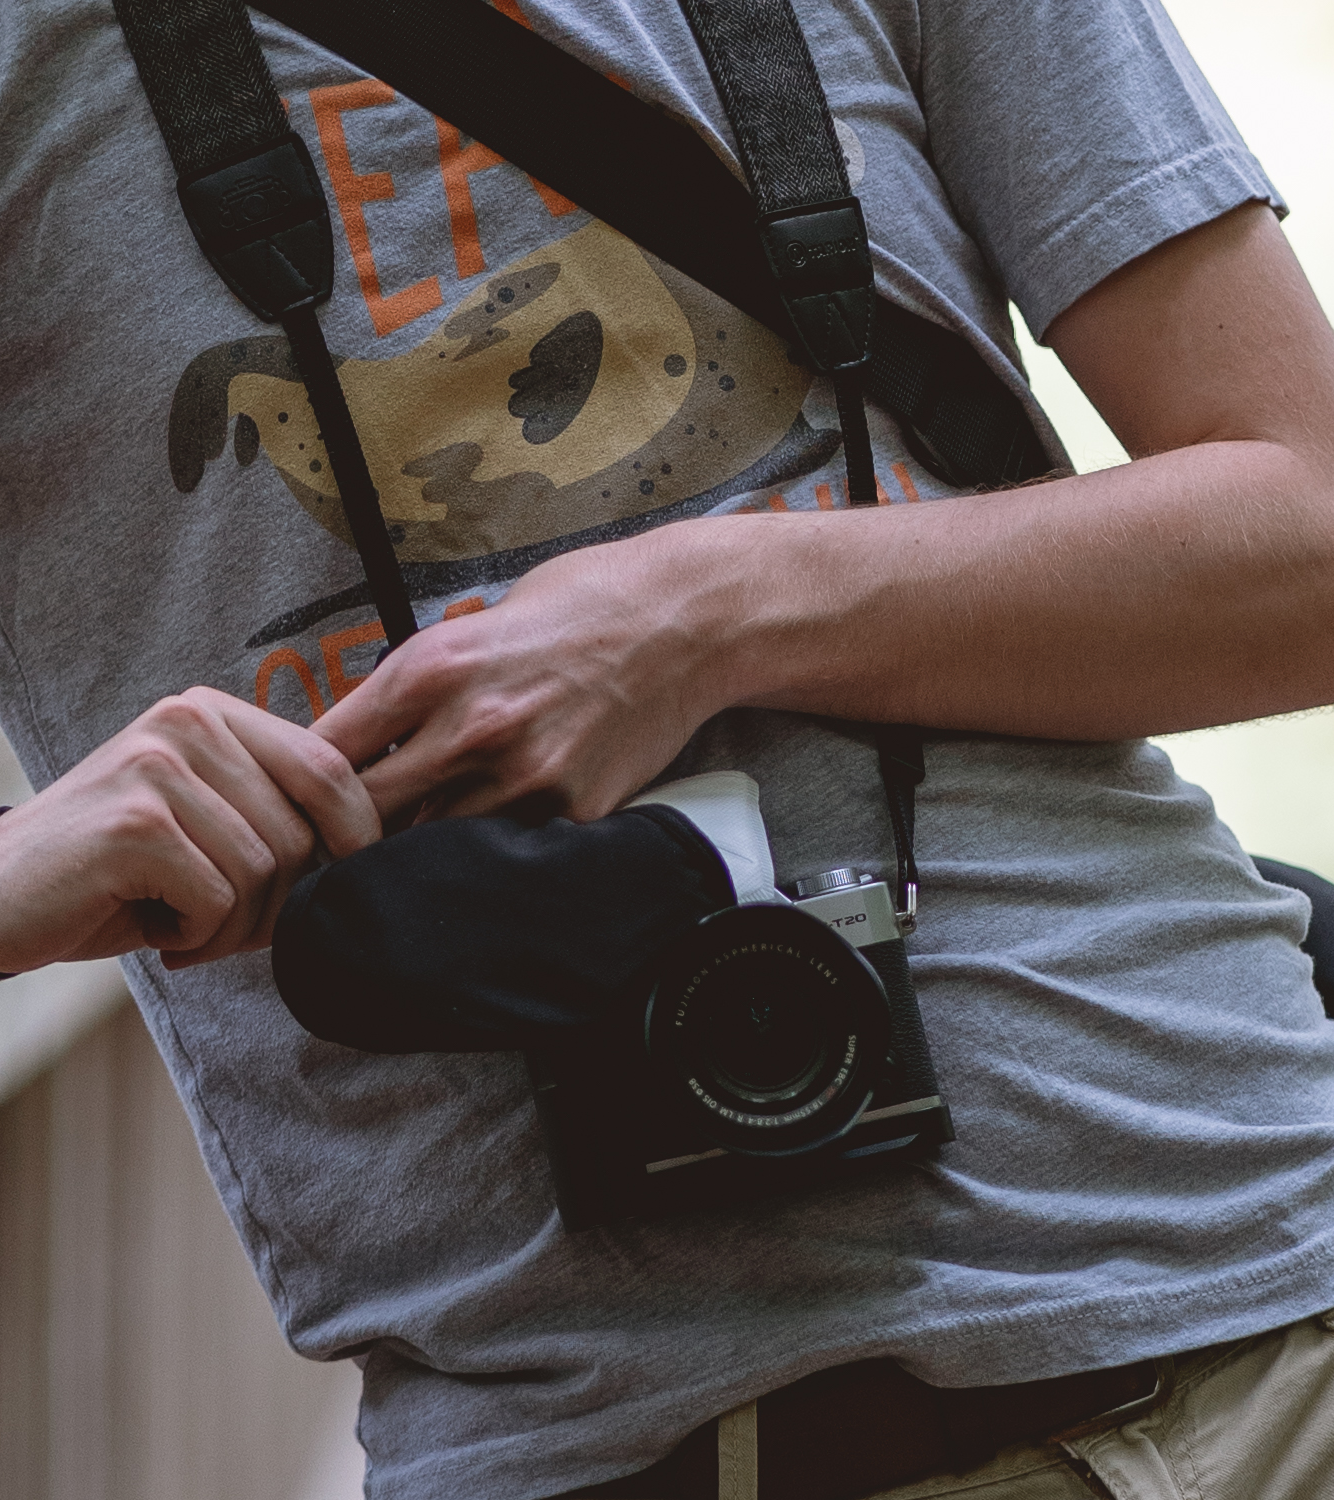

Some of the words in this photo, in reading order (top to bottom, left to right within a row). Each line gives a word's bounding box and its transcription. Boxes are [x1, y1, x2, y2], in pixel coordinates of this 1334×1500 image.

[675, 967, 709, 1027] FUJINON
[715, 942, 801, 966] ASPHERICAL
[809, 957, 838, 985] LENS
[844, 1034, 857, 1064] SUPER
[834, 1067, 849, 1086] EBC
[702, 1094, 718, 1109] OIS
